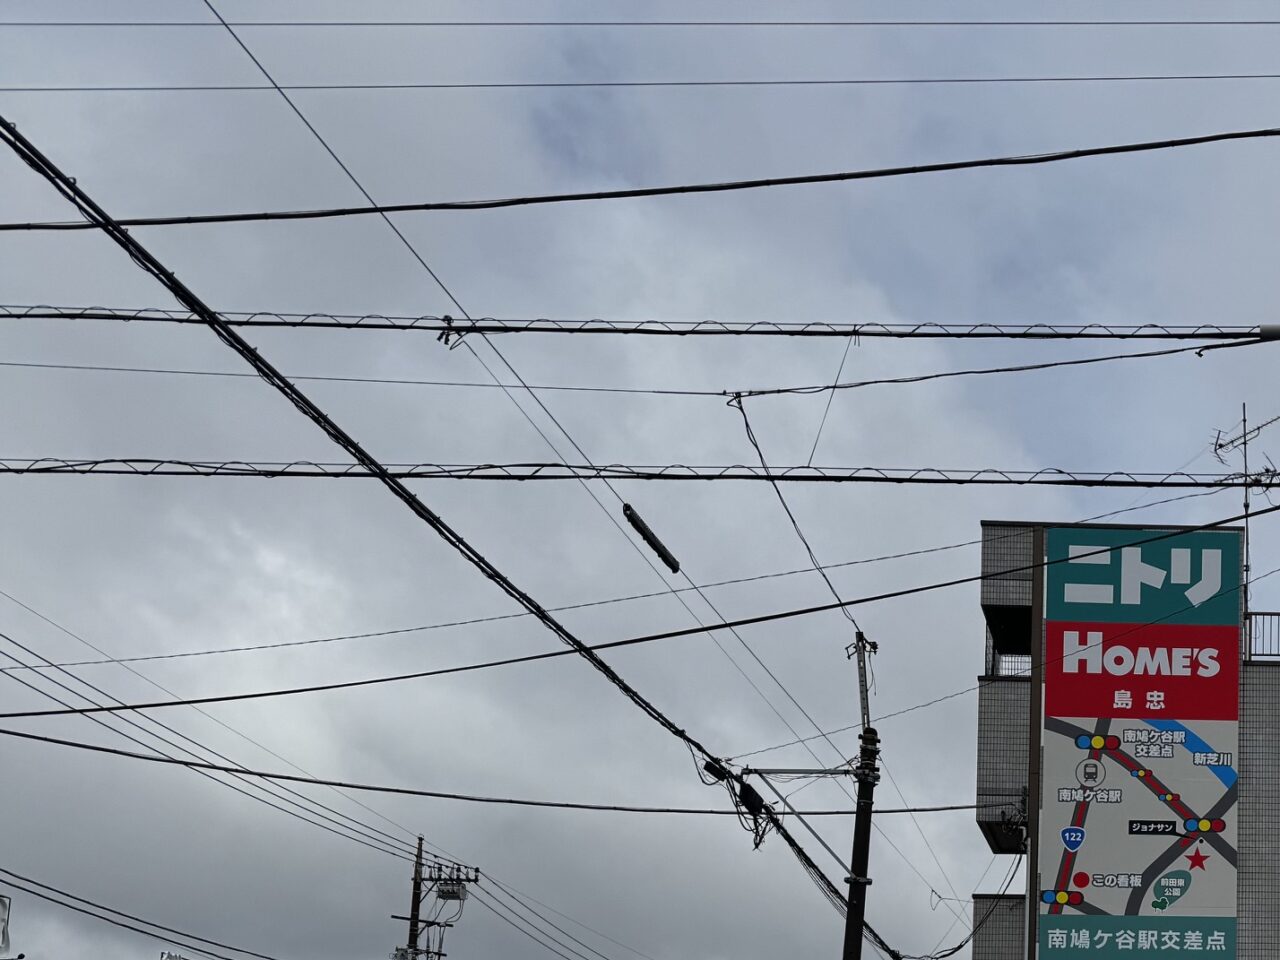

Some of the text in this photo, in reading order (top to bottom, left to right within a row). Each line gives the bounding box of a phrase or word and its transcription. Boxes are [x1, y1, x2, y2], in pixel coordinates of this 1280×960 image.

[1064, 545, 1222, 608] ニトリ
[1063, 631, 1220, 677] HOME'S
[1135, 745, 1174, 757] 交差点
[1193, 752, 1232, 766] 新芝川
[1131, 823, 1174, 832] ジョナサン
[1064, 832, 1082, 842] 122
[1092, 874, 1142, 888] この看板
[1164, 887, 1181, 896] 公園
